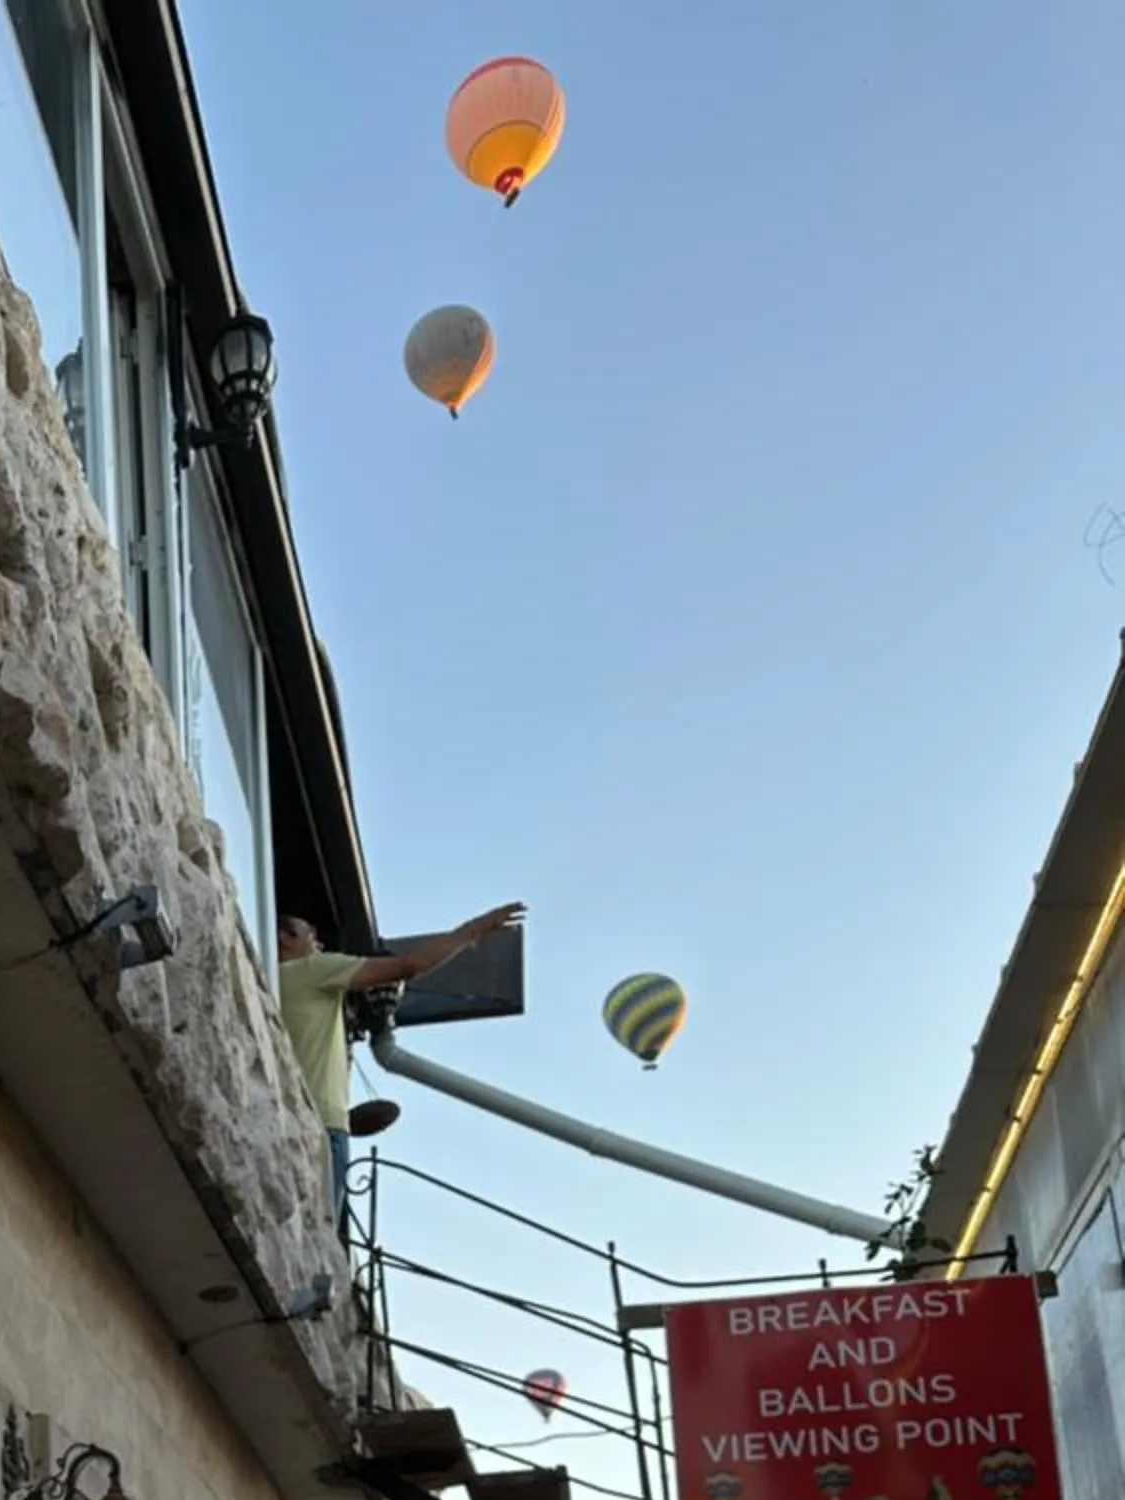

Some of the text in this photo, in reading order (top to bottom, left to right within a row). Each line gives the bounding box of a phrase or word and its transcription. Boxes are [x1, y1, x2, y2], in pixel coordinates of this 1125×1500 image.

[729, 1288, 972, 1336] BREAKFAST
[808, 1336, 896, 1371] AND
[759, 1374, 957, 1417] BALLONS
[701, 1413, 1024, 1463] VIEWING POINT
